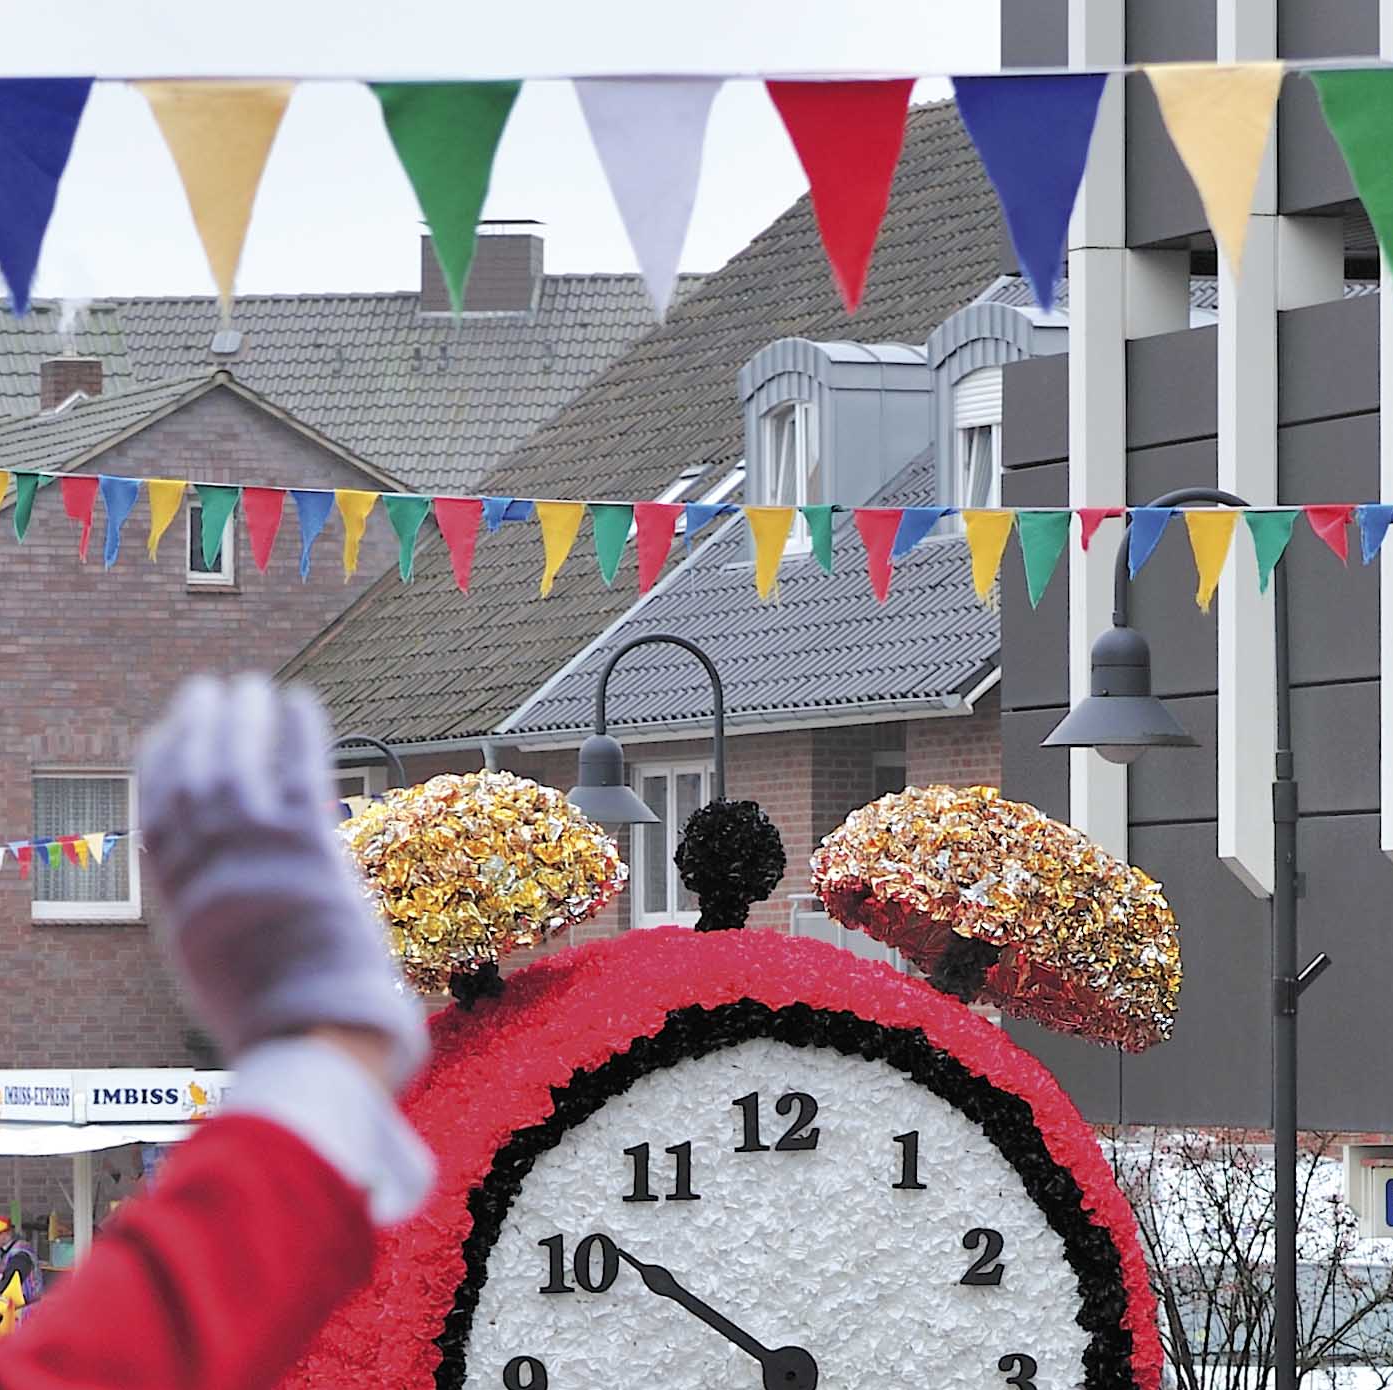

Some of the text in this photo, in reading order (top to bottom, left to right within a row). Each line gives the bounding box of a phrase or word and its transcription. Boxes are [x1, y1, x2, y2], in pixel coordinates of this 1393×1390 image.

[4, 1086, 71, 1107] IMBISS-EXPRESS
[92, 1088, 179, 1105] IMBISS
[732, 1092, 820, 1153] 12
[623, 1141, 701, 1202] 11
[892, 1131, 927, 1190] 1
[539, 1232, 620, 1294] 10
[960, 1228, 1005, 1285] 2
